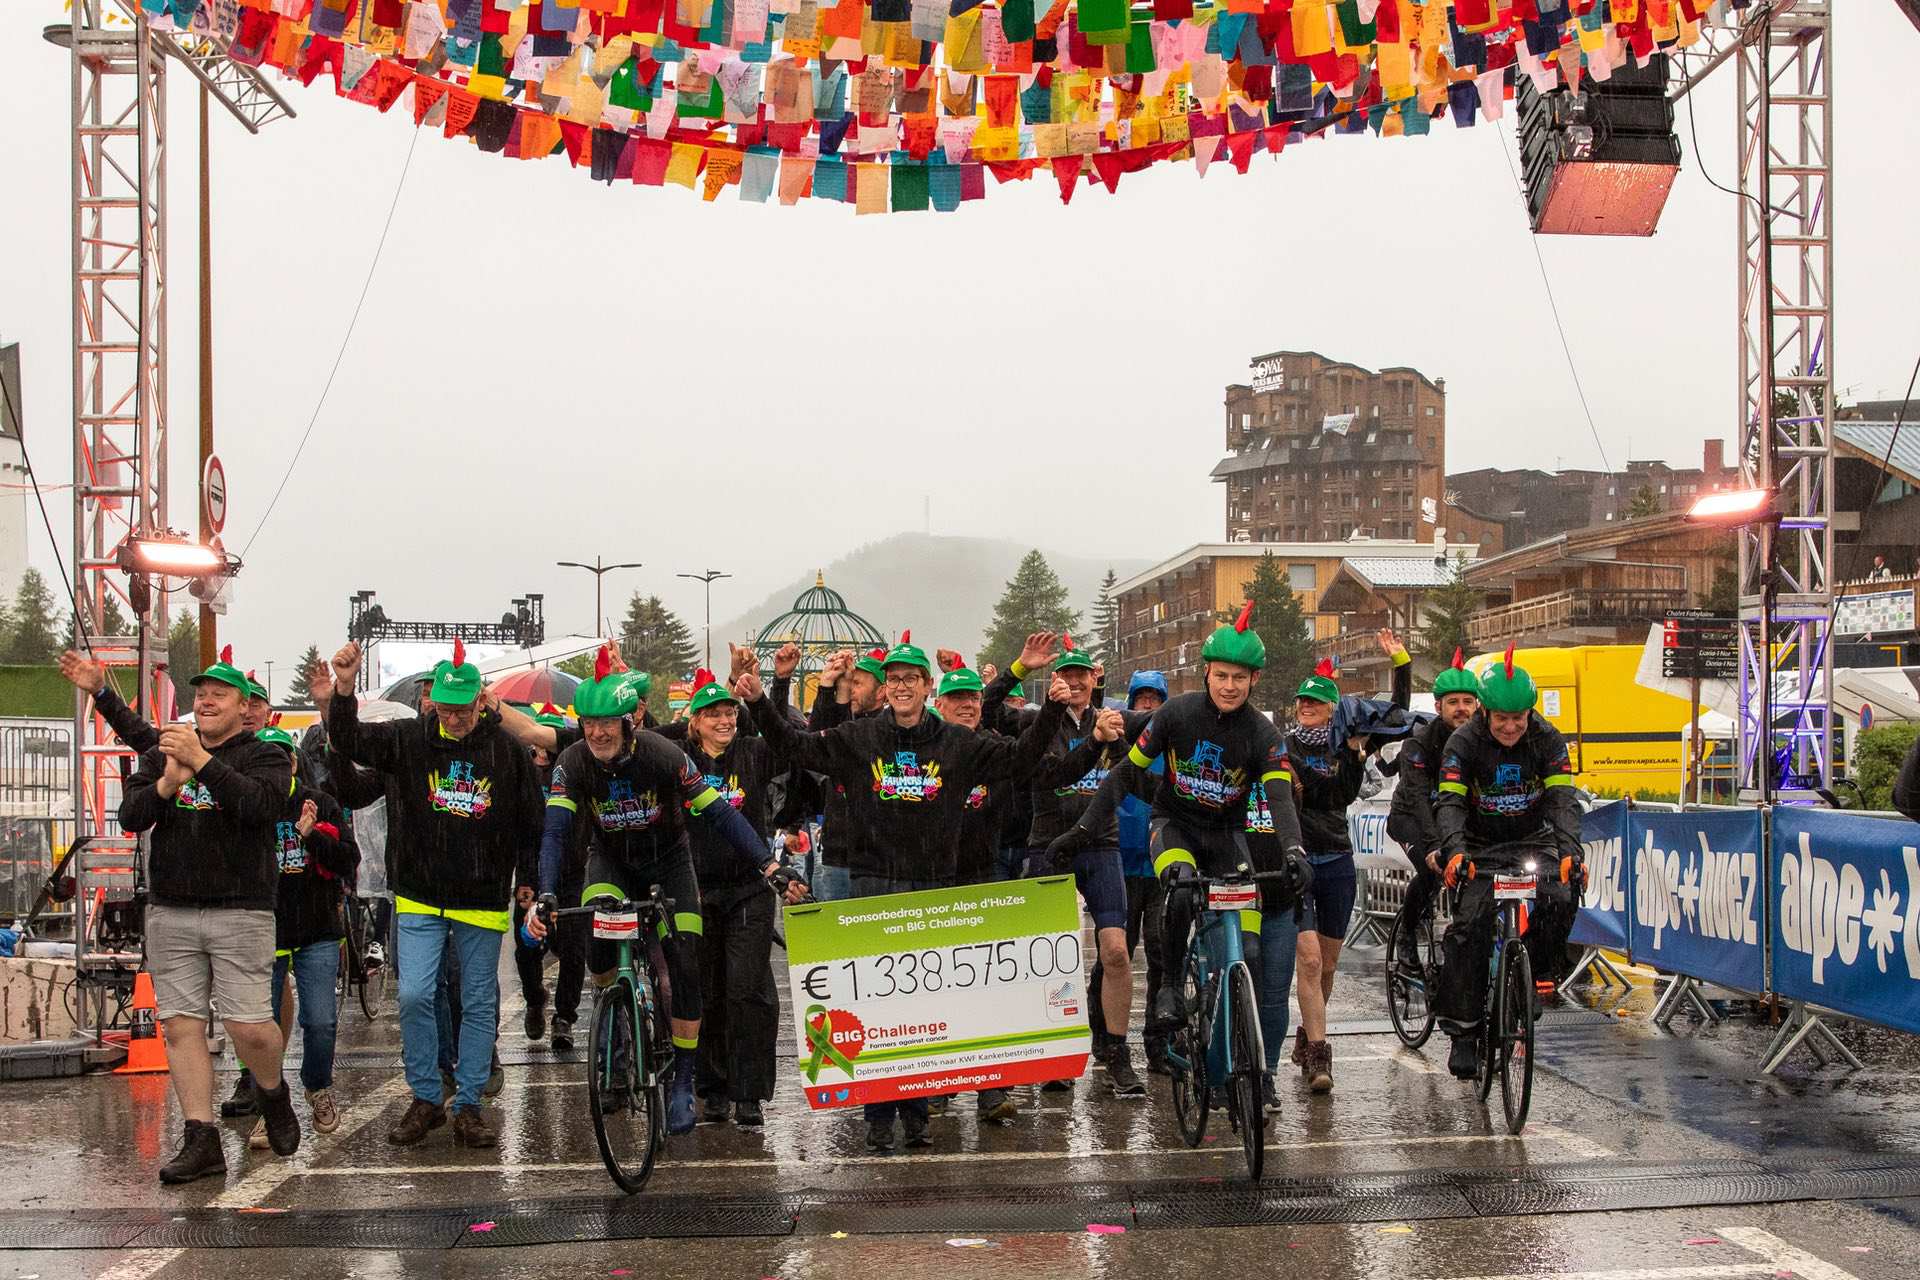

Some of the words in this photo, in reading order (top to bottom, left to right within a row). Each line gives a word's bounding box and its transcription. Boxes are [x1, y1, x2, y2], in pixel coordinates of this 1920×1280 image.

[882, 775, 922, 786] FARMERS
[1176, 772, 1223, 793] FARMERS
[436, 788, 474, 803] FARMERS
[896, 785, 924, 797] COOL
[1191, 788, 1225, 803] COOL
[447, 800, 474, 813] COOL
[599, 809, 645, 822] FARMERS
[837, 908, 923, 926] Sponsorbedrag
[925, 906, 950, 915] voor
[952, 900, 977, 913] Alpe
[980, 896, 1026, 908] d'HuZes
[883, 924, 904, 934] van
[907, 920, 926, 932] BIG
[929, 914, 985, 929] Challenge
[832, 1029, 863, 1044] BIG
[867, 1021, 948, 1040] Challenge
[869, 1041, 897, 1049] Farmers
[898, 1038, 924, 1046] against
[925, 1035, 948, 1043] cancer
[855, 1066, 896, 1076] Opbrengst
[897, 1063, 915, 1072] gaat
[917, 1060, 938, 1069] 100%
[959, 1054, 977, 1063] KWF
[978, 1047, 1045, 1060] Kankerbestrijding
[898, 1072, 1002, 1091] www.bigchallenge.eu
